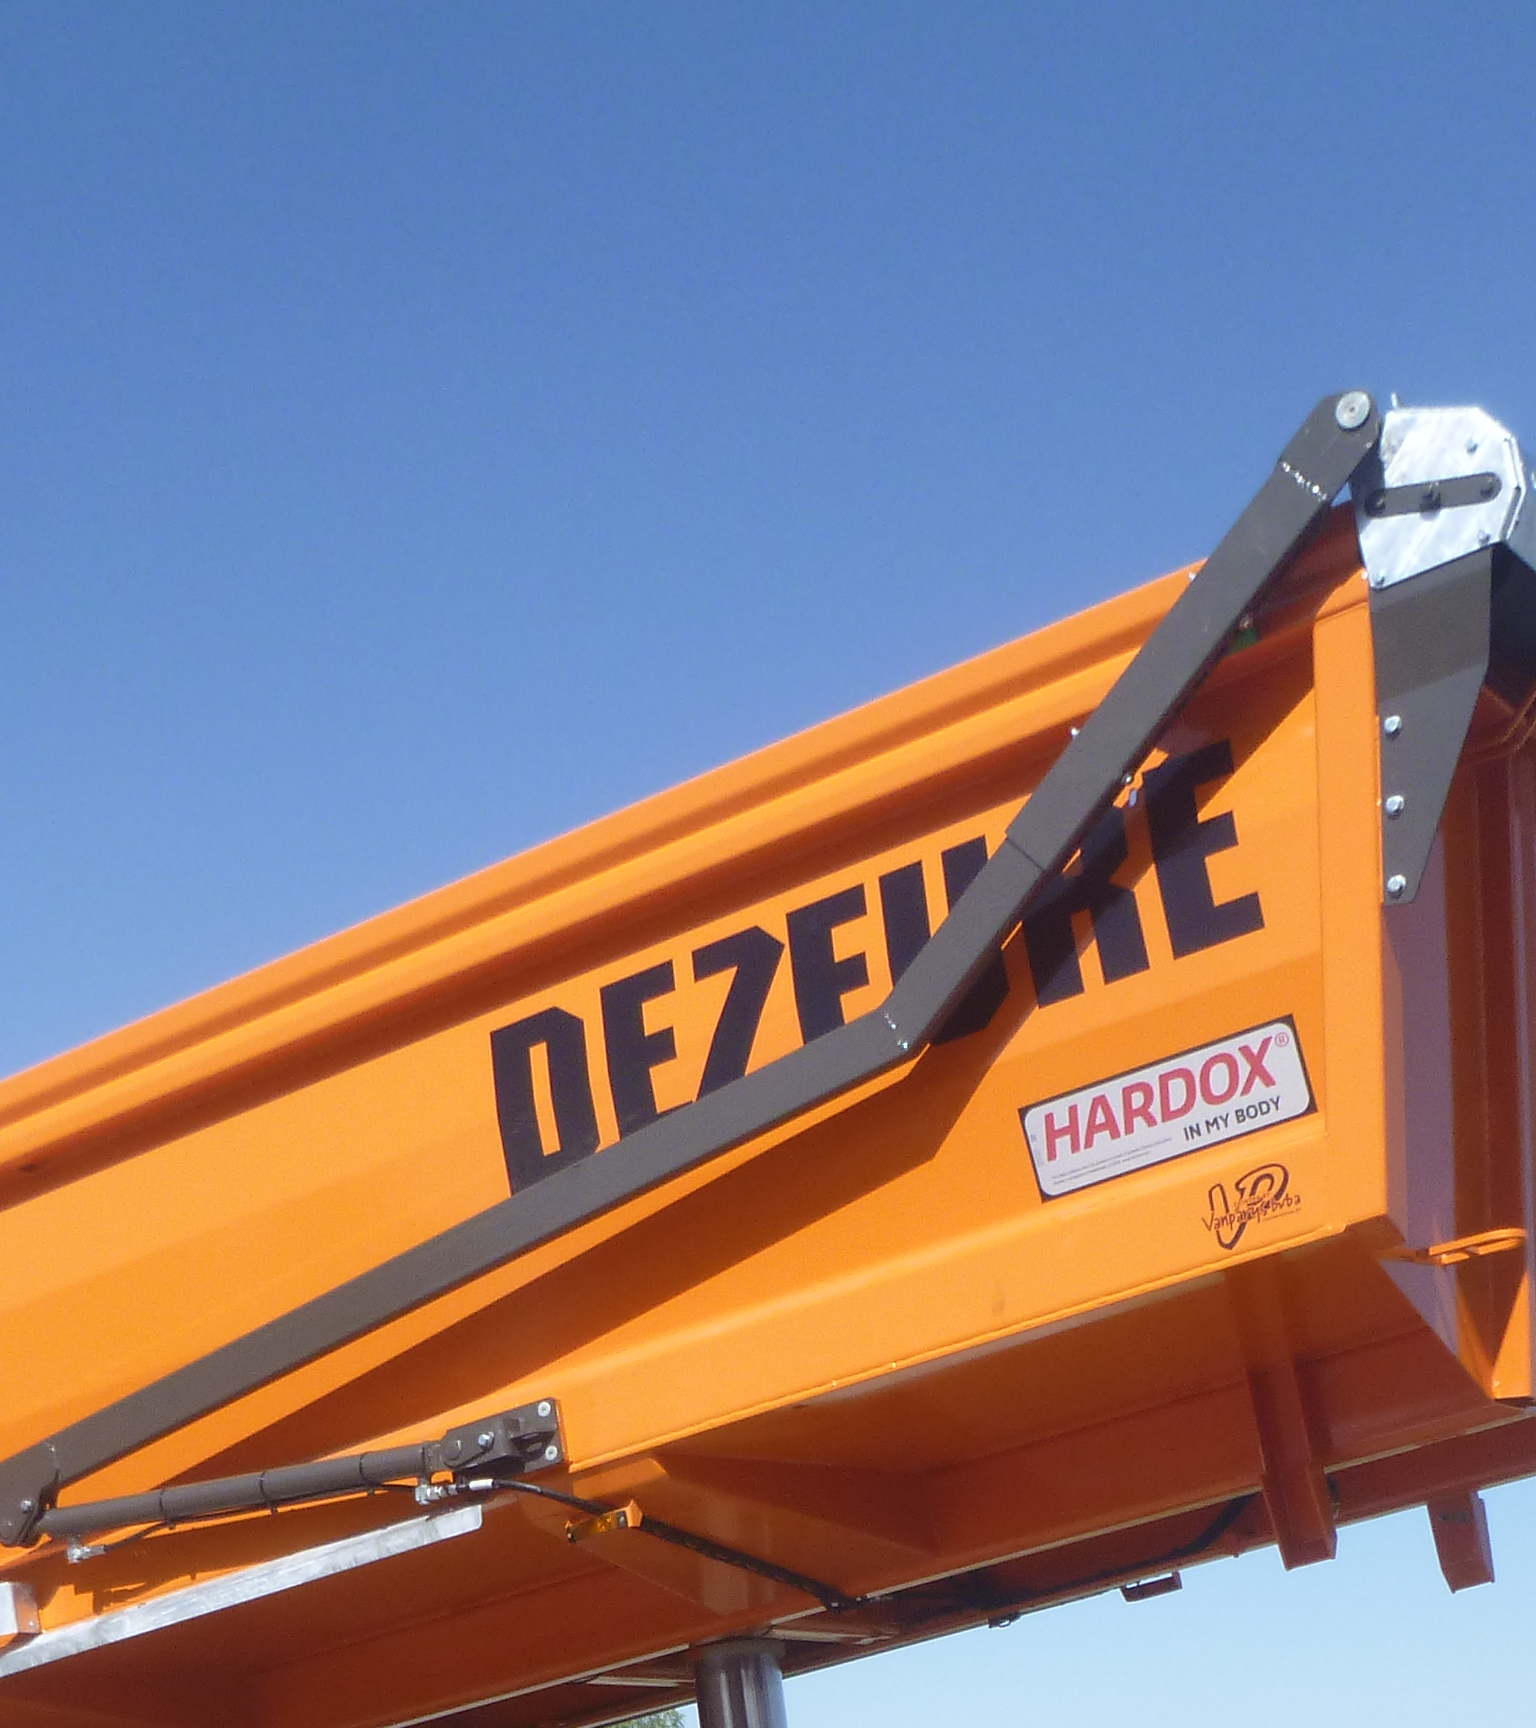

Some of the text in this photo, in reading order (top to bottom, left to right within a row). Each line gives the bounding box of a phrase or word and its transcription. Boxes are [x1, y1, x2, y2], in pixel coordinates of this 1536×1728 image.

[1184, 1096, 1282, 1142] IN MY BODY
